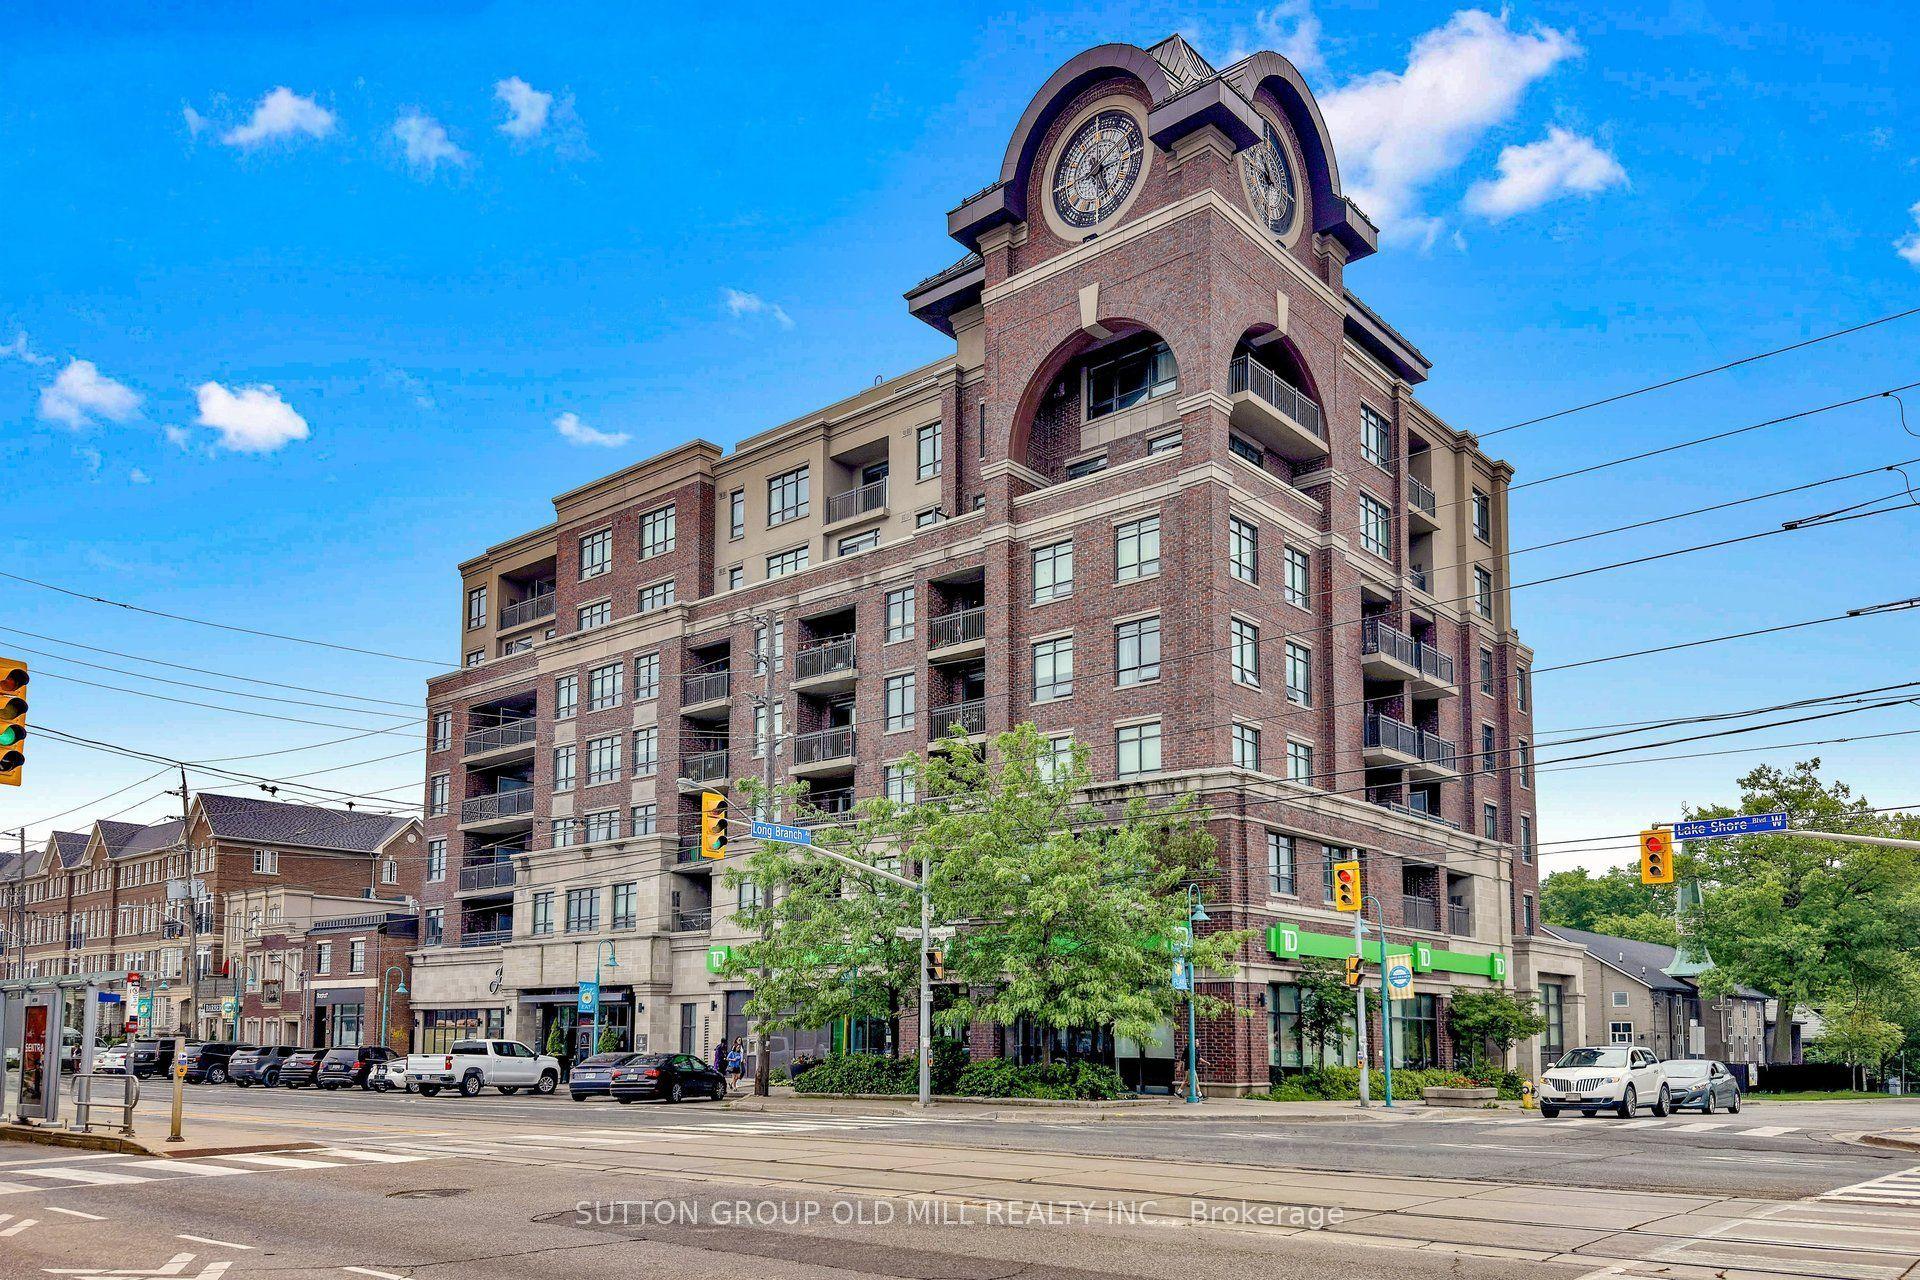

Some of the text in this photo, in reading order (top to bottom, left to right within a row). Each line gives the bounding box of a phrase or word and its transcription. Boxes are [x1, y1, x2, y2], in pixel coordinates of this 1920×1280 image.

[752, 822, 772, 839] Long
[775, 826, 803, 840] Branch
[1677, 815, 1782, 836] Lake Shore Blvd W
[1281, 929, 1298, 952] TD
[710, 950, 726, 967] TD
[1418, 947, 1431, 967] TD
[1494, 958, 1505, 975] TD
